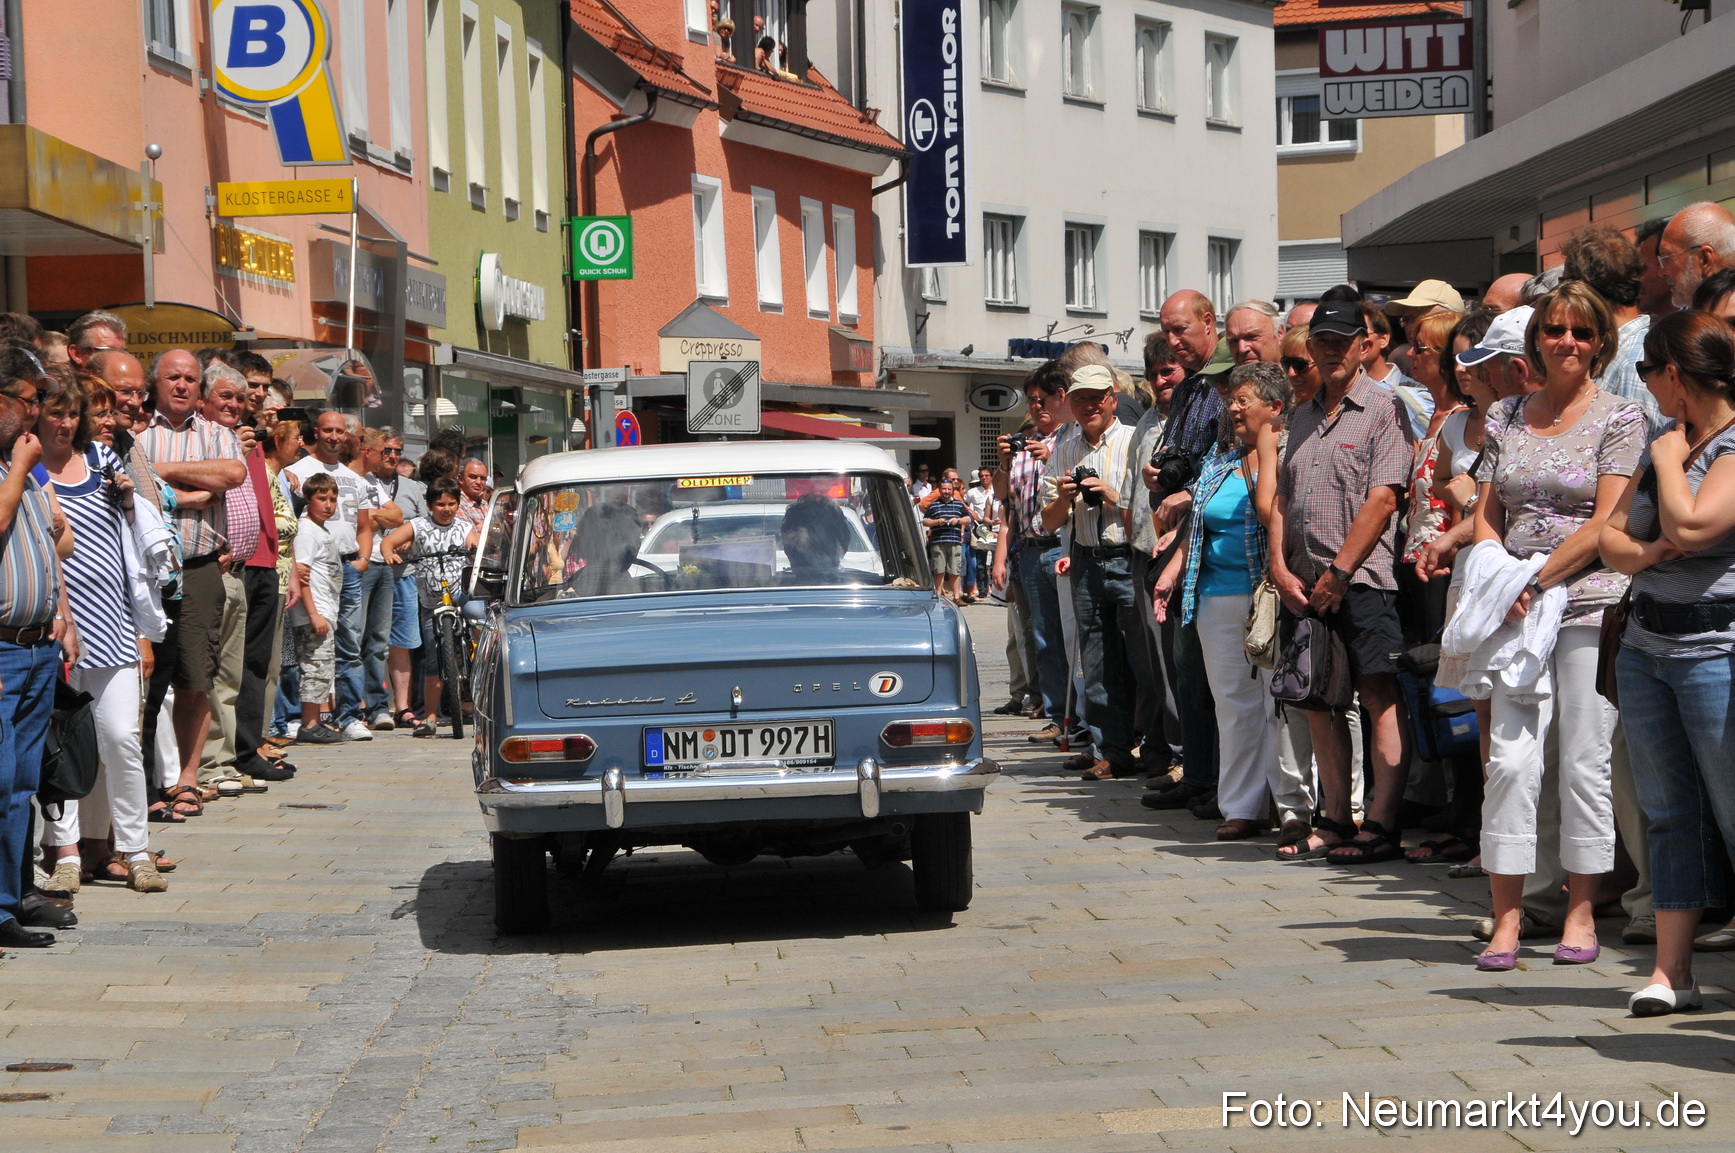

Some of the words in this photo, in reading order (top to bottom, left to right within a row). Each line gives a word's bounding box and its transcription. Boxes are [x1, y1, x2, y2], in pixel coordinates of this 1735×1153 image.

[226, 4, 286, 69] B
[1325, 22, 1466, 74] WITT
[942, 7, 958, 139] TAILOR
[1324, 74, 1470, 116] WEIDEN
[225, 188, 331, 206] KLOSTERGASSE
[337, 189, 344, 201] 4
[945, 144, 961, 239] TOM
[579, 268, 602, 276] QUICK
[603, 267, 627, 275] SCHUH
[680, 339, 743, 360] Creppresso
[706, 414, 742, 426] ZONE
[793, 681, 862, 693] OPEL
[878, 675, 897, 694] D
[664, 730, 699, 760] NM
[720, 728, 754, 758] DT
[651, 751, 659, 759] D
